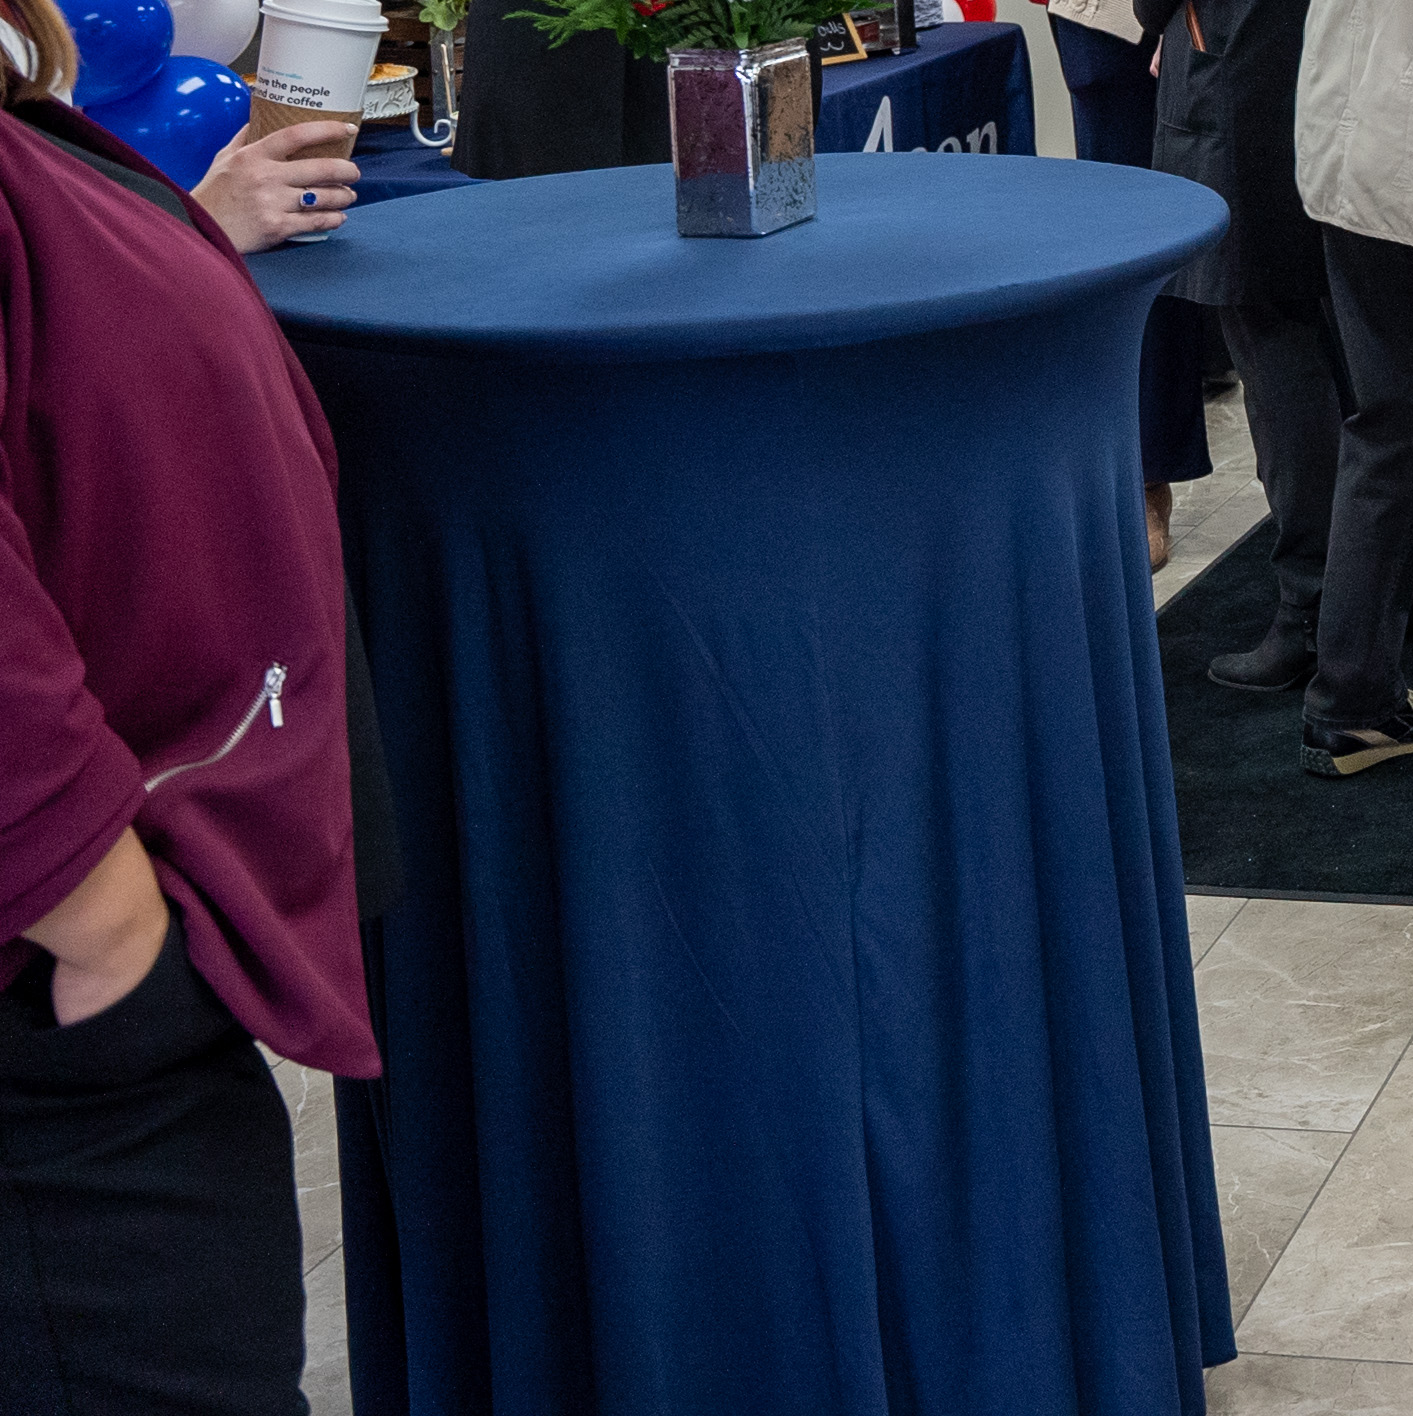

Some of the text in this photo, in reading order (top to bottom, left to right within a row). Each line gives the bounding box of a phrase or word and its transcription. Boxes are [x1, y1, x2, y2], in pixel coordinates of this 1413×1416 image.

[271, 79, 288, 90] the
[289, 86, 331, 97] people
[268, 92, 324, 108] our coffee
